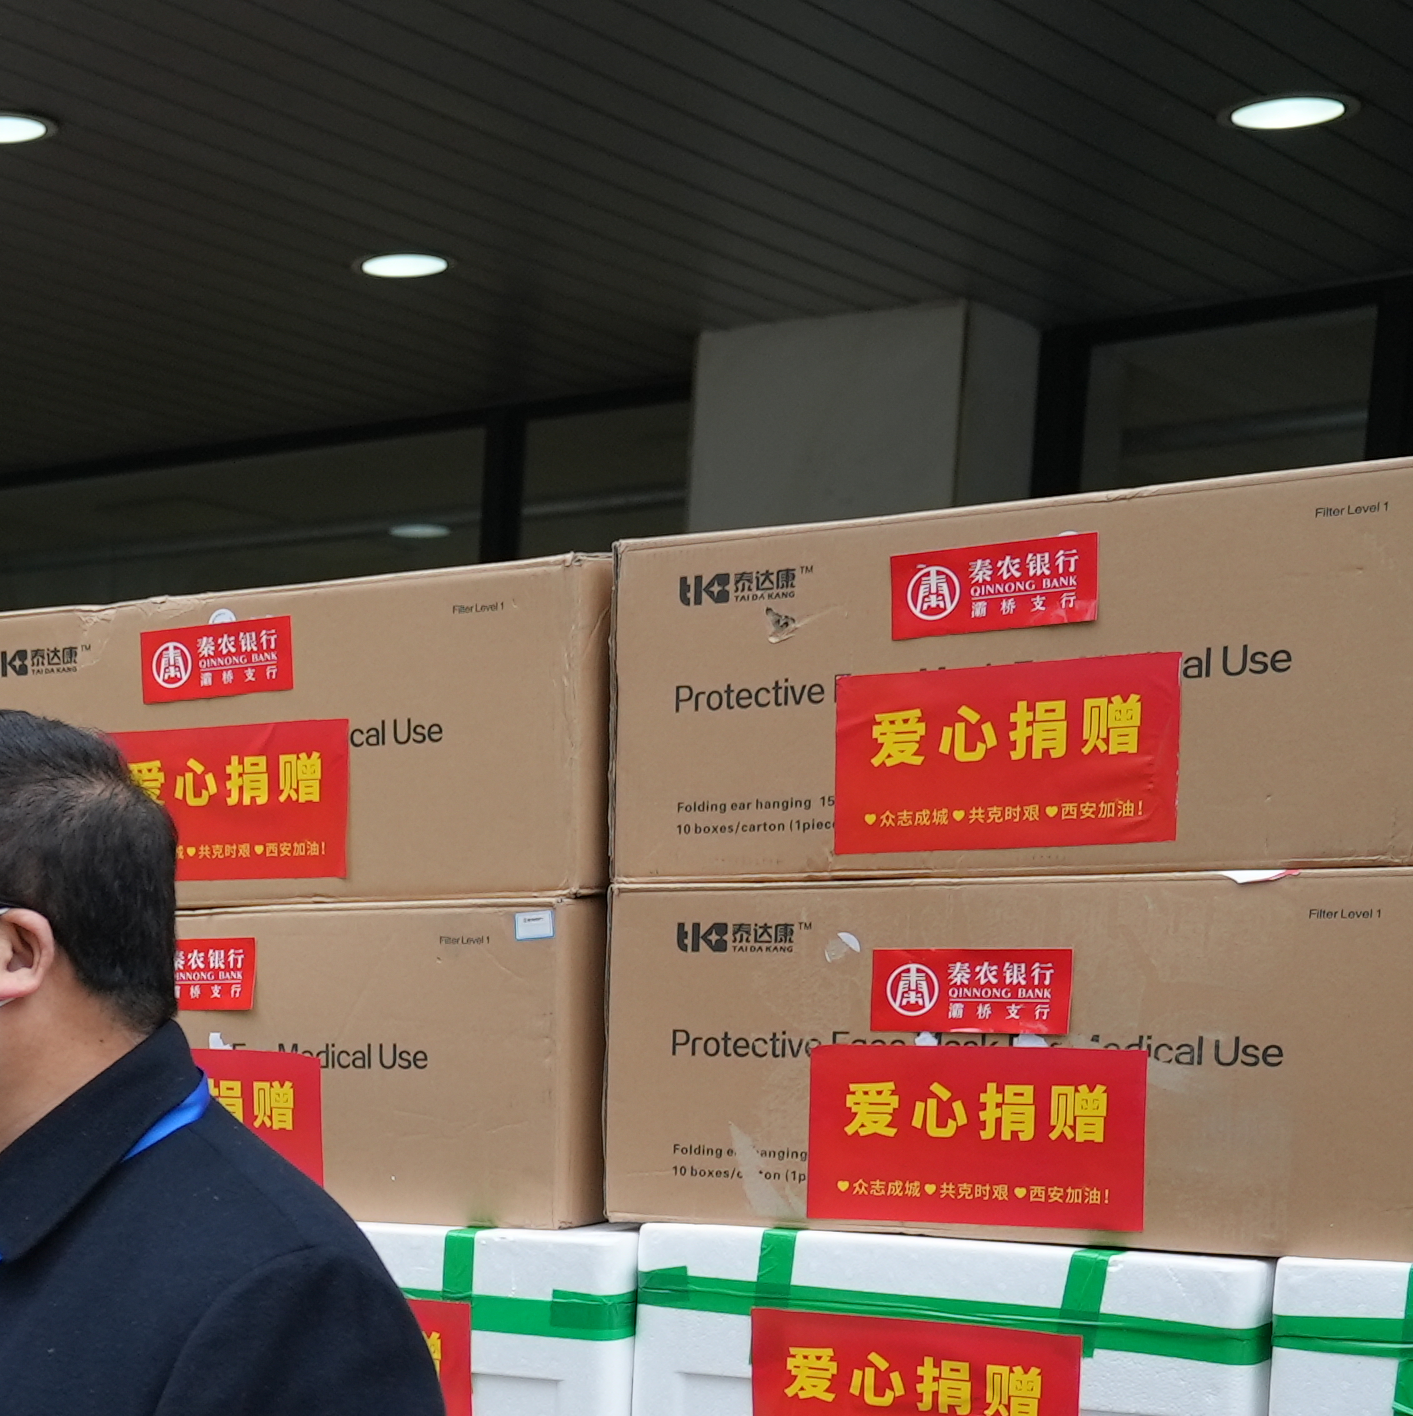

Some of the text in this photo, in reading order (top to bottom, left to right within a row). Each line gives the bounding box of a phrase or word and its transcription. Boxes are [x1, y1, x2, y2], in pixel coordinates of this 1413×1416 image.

[1314, 501, 1390, 519] Filter Level 1
[968, 548, 1080, 584] 秦农银行
[734, 568, 796, 593] 泰达康
[970, 575, 1079, 598] QINNONG BANK
[970, 591, 1078, 619] 灞桥支行
[196, 629, 279, 658] 秦农银行
[31, 646, 78, 668] 泰达康
[198, 651, 279, 670] QINNONG BANK
[674, 676, 826, 713] Protective
[1222, 644, 1293, 677] Use
[392, 717, 444, 746] Use
[870, 694, 1144, 769] 爱心捐赠
[676, 799, 727, 815] Folding
[730, 801, 753, 812] ear
[755, 796, 812, 812] hanging
[879, 798, 1145, 828] 众志成城 共克时艰 西安加油!
[676, 820, 786, 836] 10 boxes/carton
[198, 843, 251, 860] 共克时艰
[1308, 908, 1383, 920] Filter Level 1
[731, 922, 795, 944] 泰达康
[218, 970, 243, 981] BANK
[947, 961, 1055, 986] 秦农银行
[948, 986, 1053, 1000] QINNONG BANK
[948, 1003, 1051, 1021] 灞桥支行
[378, 1043, 429, 1070] Use
[1213, 1035, 1285, 1069] Use
[843, 1080, 1109, 1143] 爱心捐赠
[672, 1143, 808, 1162] Folding anging
[672, 1165, 687, 1177] 10
[852, 1178, 1111, 1205] 众志成城 共克时艰 西安加油!
